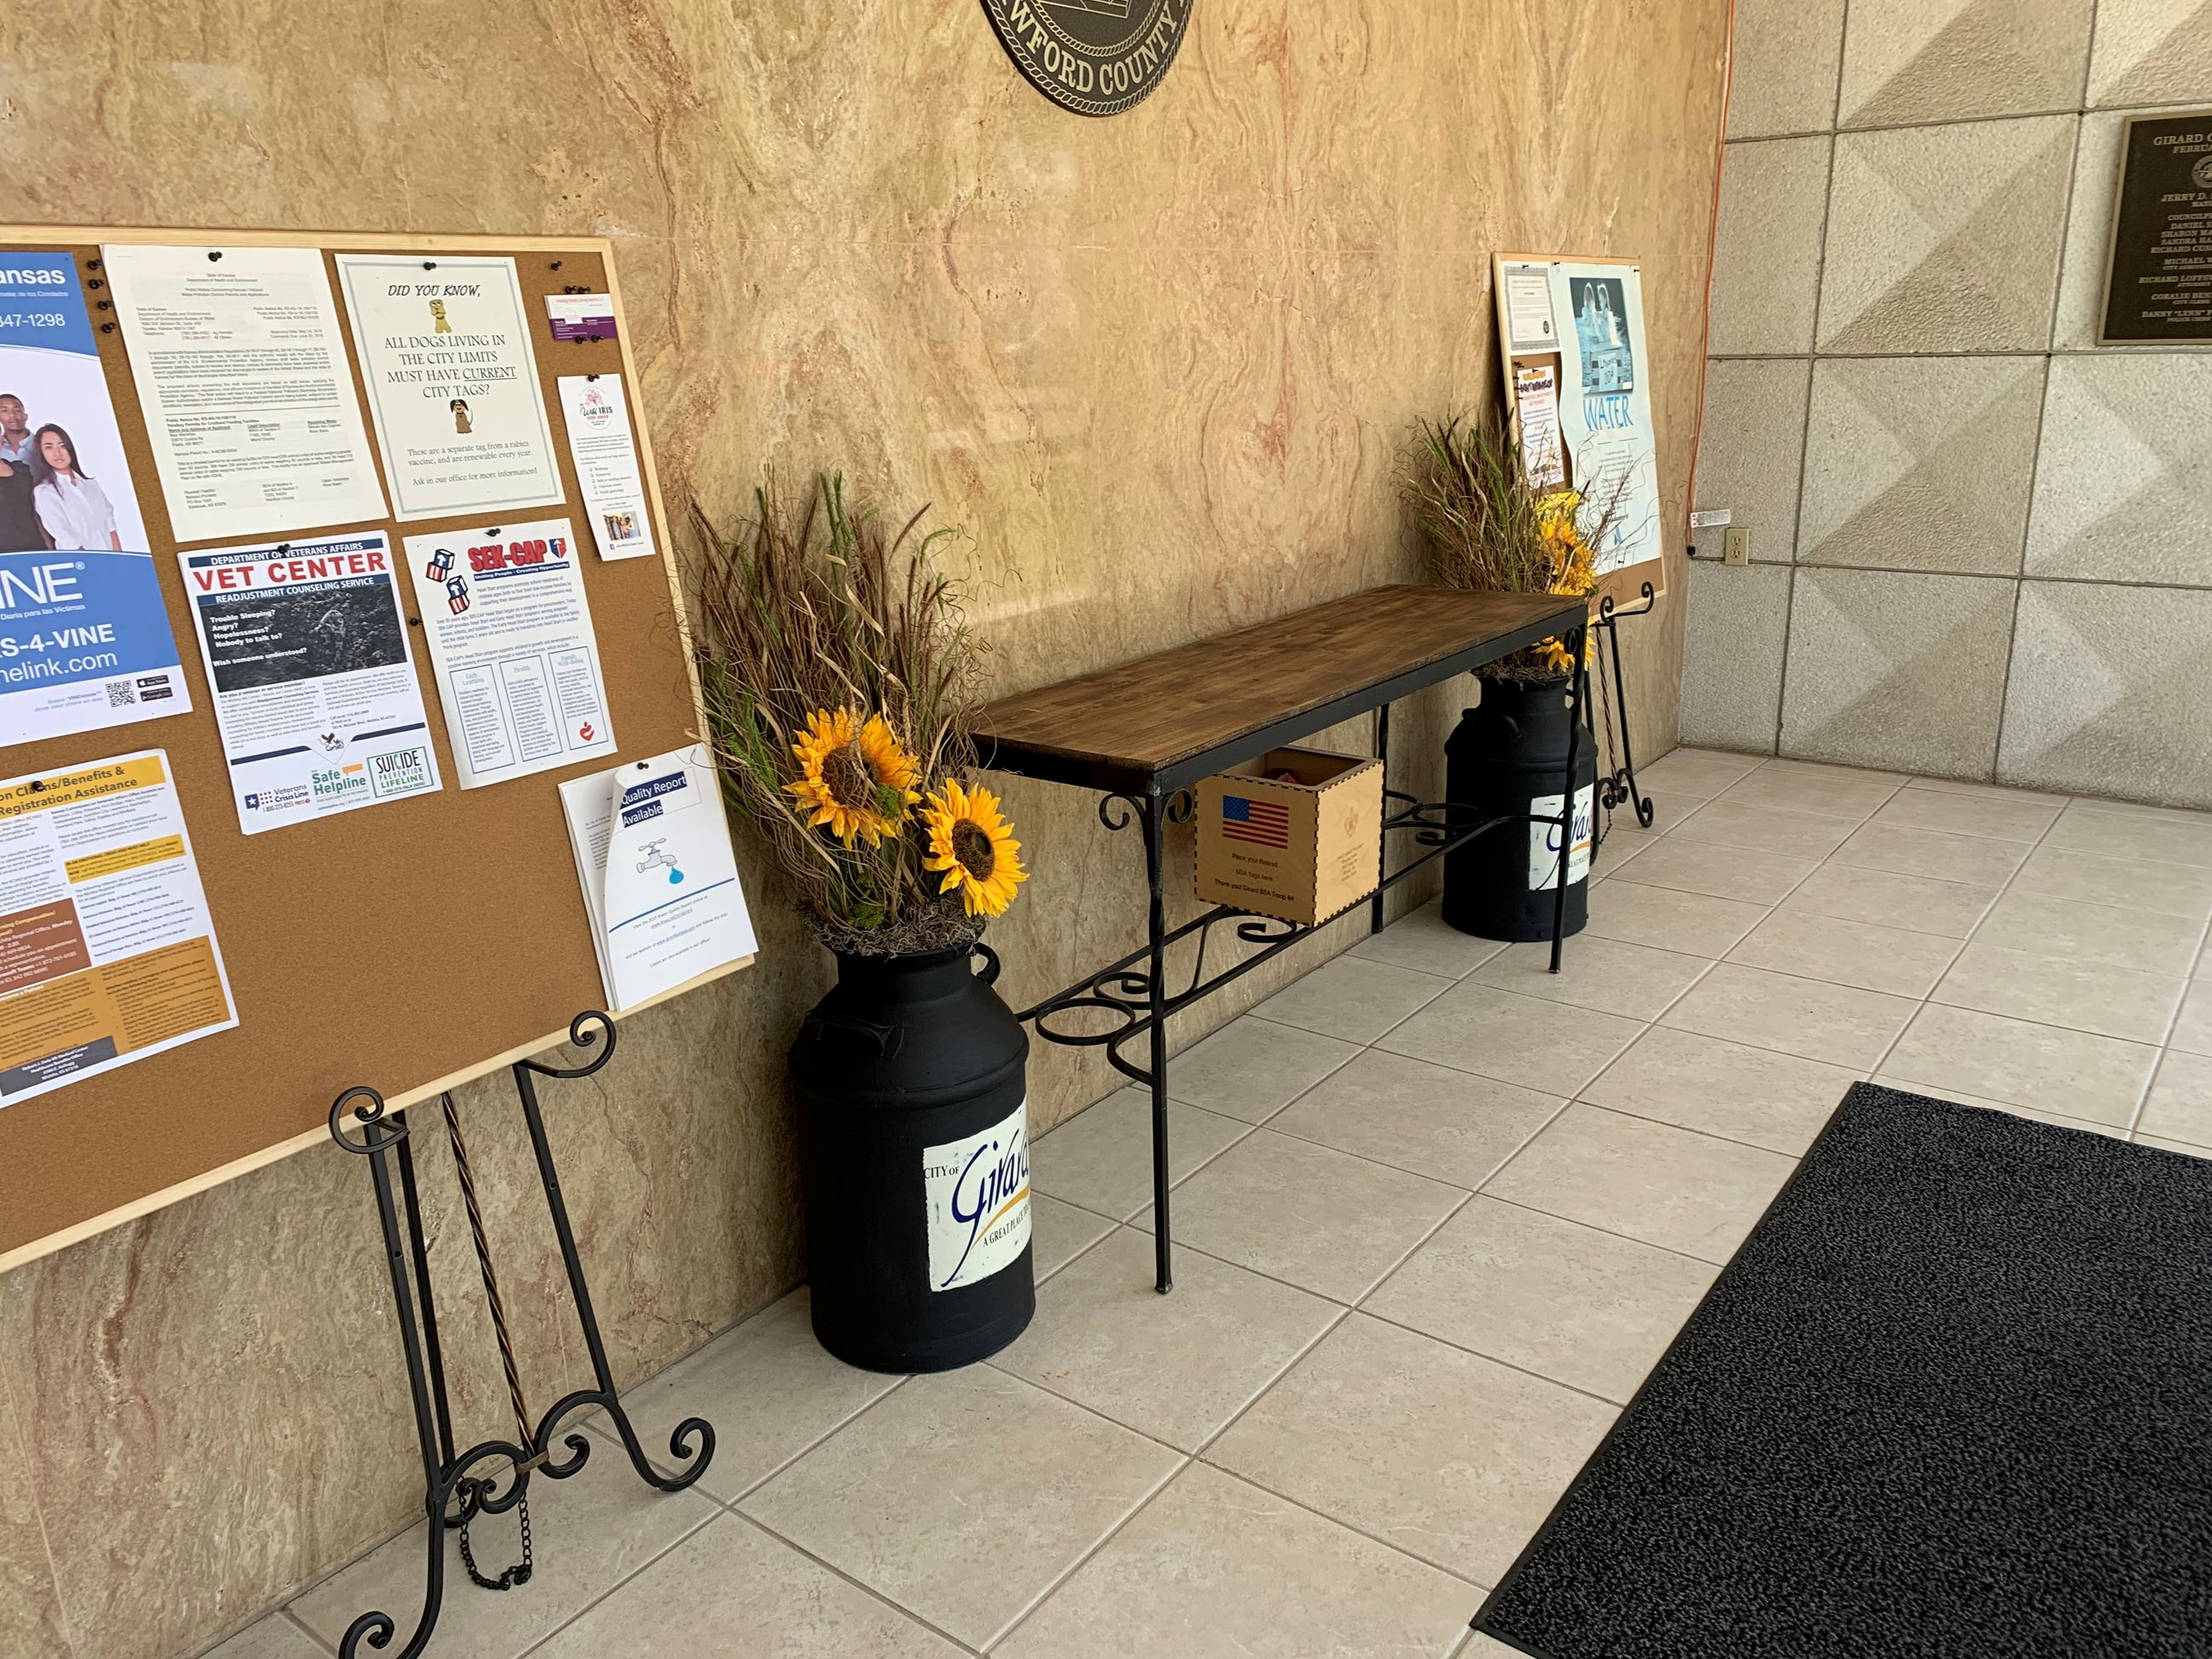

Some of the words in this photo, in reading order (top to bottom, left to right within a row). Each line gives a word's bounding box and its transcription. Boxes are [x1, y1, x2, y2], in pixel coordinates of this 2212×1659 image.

[1003, 0, 1093, 93] WFORD
[1099, 2, 1178, 95] COUNTY
[2153, 134, 2203, 145] GIRARD
[2161, 193, 2196, 202] JERRY
[2161, 230, 2198, 238] SHARON
[2161, 237, 2197, 246] SANDRA
[2164, 257, 2205, 265] MICHAEL
[388, 285, 410, 296] DID
[415, 285, 440, 296] YOU
[443, 284, 481, 297] KNOW,
[385, 337, 407, 349] ALL
[408, 336, 445, 349] DOGS
[448, 335, 489, 347] LIVING
[492, 334, 506, 345] IN
[398, 353, 425, 365] THE
[427, 352, 454, 364] CITY
[458, 351, 498, 363] LIMITS
[387, 371, 423, 383] MUST
[426, 369, 460, 381] HAVE
[463, 367, 516, 379] CURRENT
[423, 386, 450, 398] CITY
[453, 385, 490, 396] TAGS?
[1582, 395, 1633, 431] WATER
[448, 446, 475, 454] separate
[408, 458, 436, 466] vaccine,
[464, 452, 498, 461] renewable
[499, 451, 516, 460] every
[517, 450, 533, 459] year.
[448, 473, 467, 482] office
[468, 472, 479, 481] for
[497, 467, 538, 477] information!
[211, 552, 270, 565] DEPARTMENT
[285, 548, 328, 558] VETERANS
[330, 543, 363, 553] AFFAIRS
[468, 539, 548, 572] SEK-CAP
[192, 566, 254, 591] VET
[268, 552, 387, 583] CENTER
[215, 588, 285, 603] READJUSTMENT
[287, 582, 339, 595] COUNSELING
[341, 578, 374, 588] SERVICE
[209, 615, 238, 624] Trouble
[240, 609, 276, 619] Sleeping?
[213, 623, 238, 632] Angry?
[214, 626, 269, 640] Hopelessness?
[0, 624, 116, 658] S-4-VINE
[215, 639, 244, 647] Nobody
[213, 658, 231, 667] Wish
[231, 655, 265, 664] someone
[265, 647, 307, 658] understood?
[376, 750, 420, 774] SUICIDE
[15, 769, 113, 797] Clams/Benefits
[116, 766, 125, 776] &
[312, 770, 340, 784] Safe
[379, 767, 423, 781] PREVENTION
[381, 774, 425, 789] LIFELINE
[75, 778, 138, 799] Assistance
[274, 784, 307, 795] Veterans
[313, 778, 366, 795] Helpline
[623, 788, 652, 805] Quality
[653, 776, 687, 794] Report
[275, 794, 294, 802] Crisis
[624, 805, 664, 826] Available
[1232, 852, 1246, 861] Place
[1215, 879, 1230, 887] Thank
[1242, 885, 1259, 893] Girard
[1260, 888, 1271, 897] BSA
[1273, 892, 1286, 900] Troop
[924, 1166, 948, 1179] CITY
[949, 1166, 960, 1176] OF
[983, 1237, 989, 1247] A
[989, 1223, 1010, 1244] GREAT
[1011, 1213, 1023, 1231] PLACE
